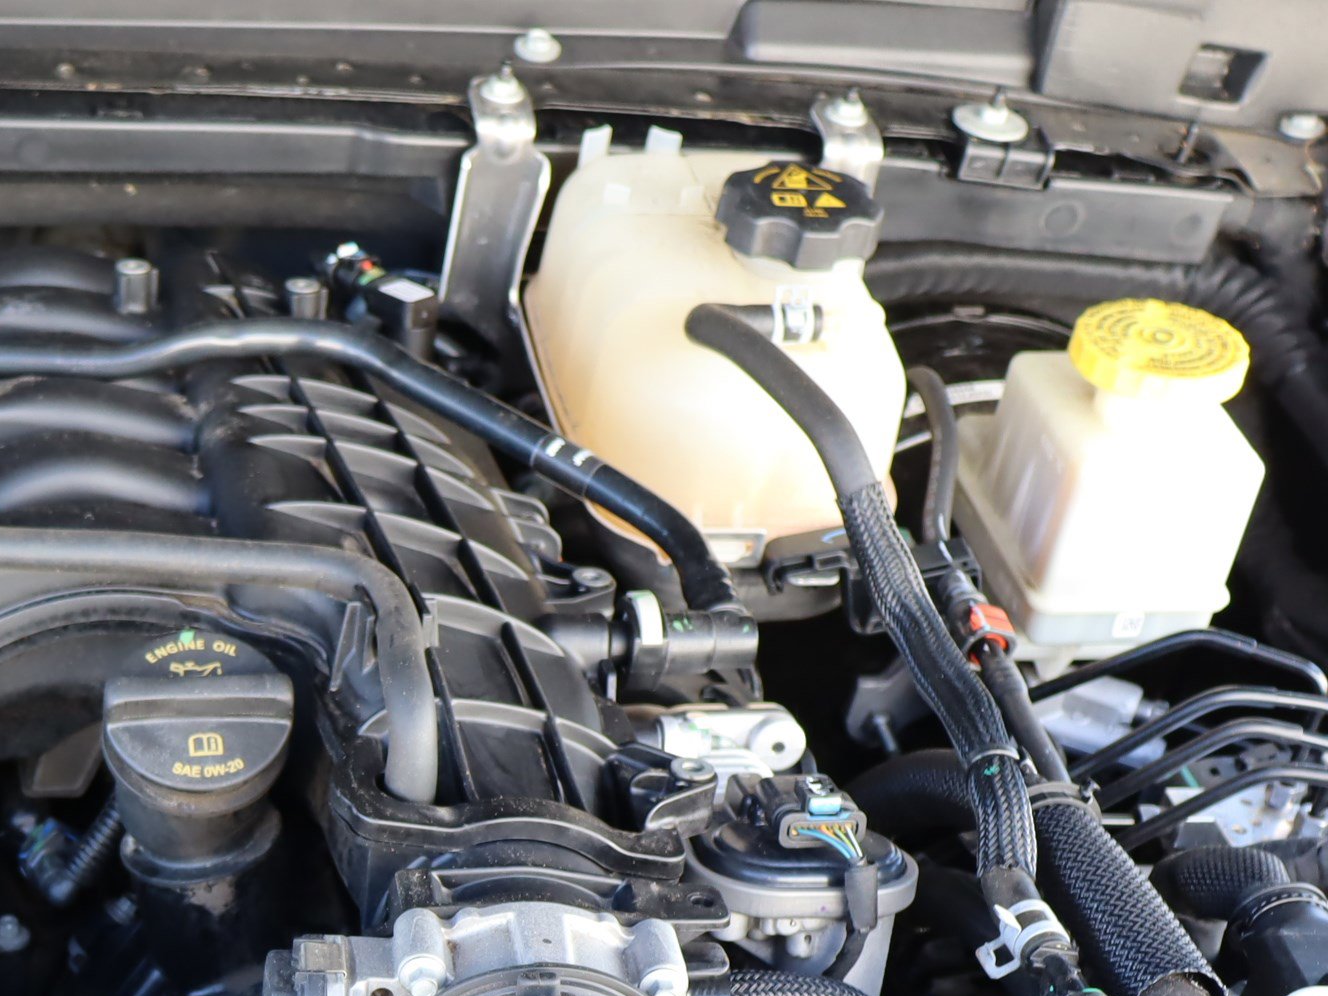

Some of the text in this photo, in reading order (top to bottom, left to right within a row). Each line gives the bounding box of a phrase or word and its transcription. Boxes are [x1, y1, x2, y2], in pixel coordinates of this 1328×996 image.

[145, 639, 236, 664] ENGINE OIL
[172, 758, 244, 778] SAE 0W-20
